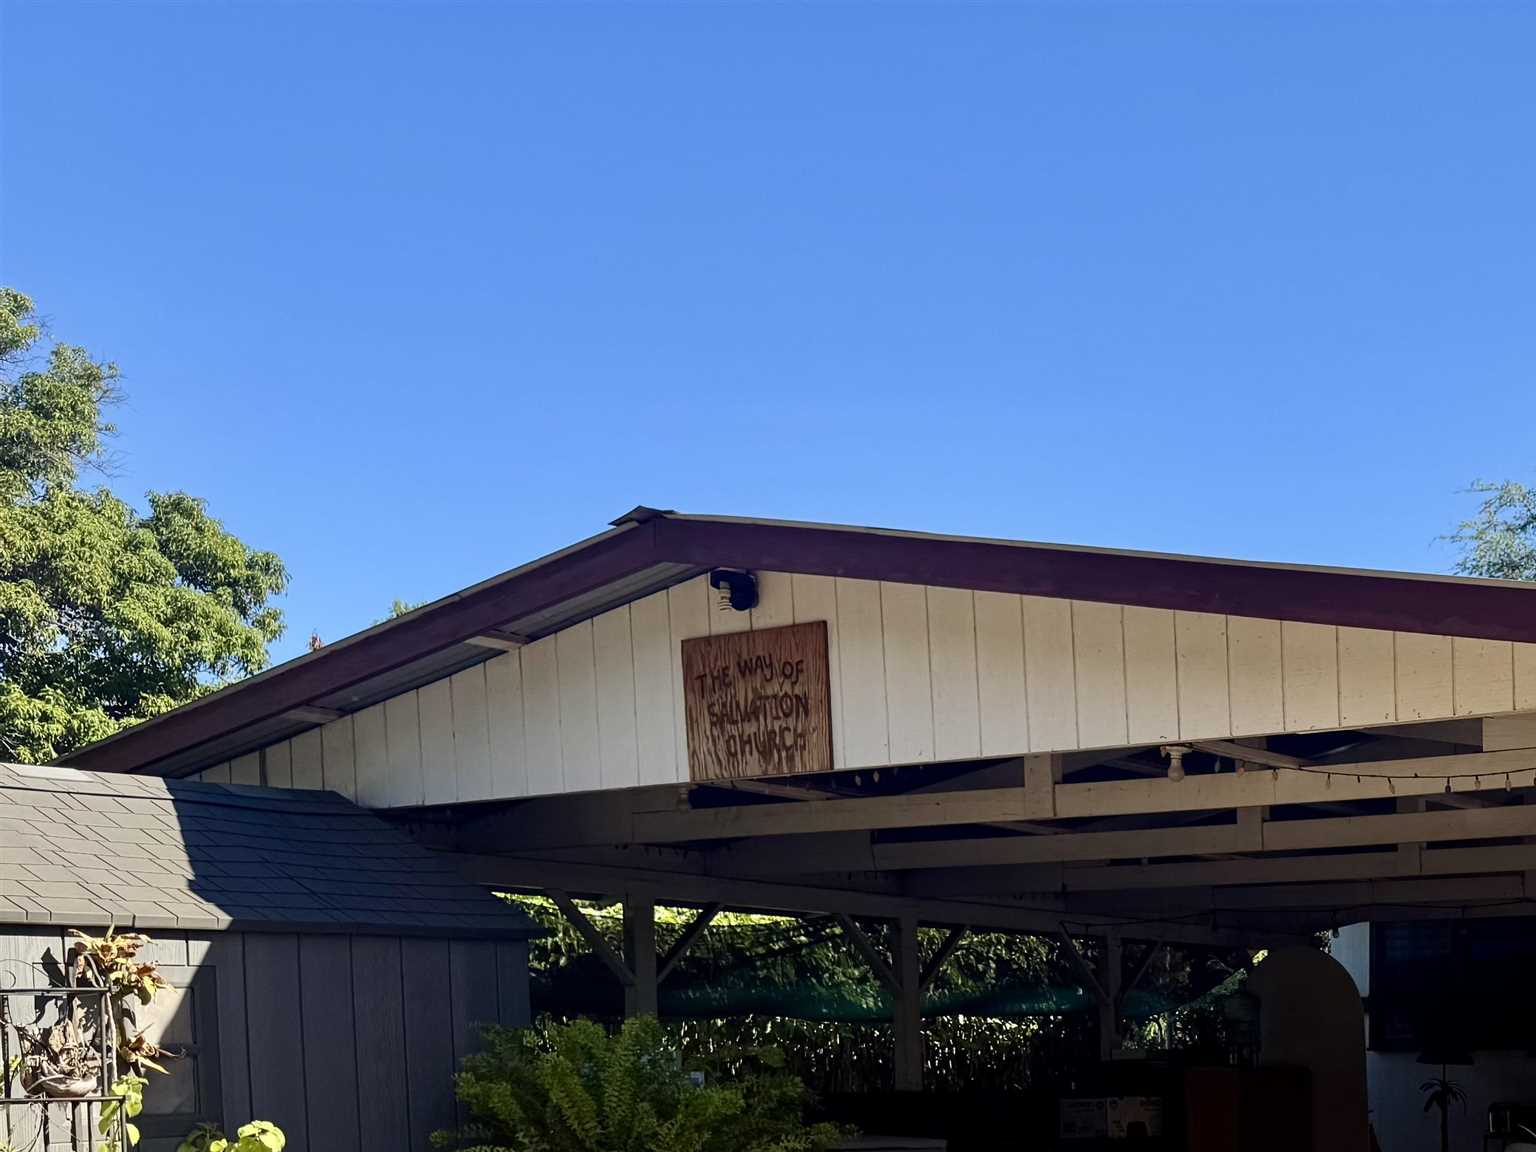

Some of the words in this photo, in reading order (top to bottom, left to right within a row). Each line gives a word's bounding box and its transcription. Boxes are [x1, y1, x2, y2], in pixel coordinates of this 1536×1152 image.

[695, 666, 732, 699] THE
[737, 653, 774, 683] WAY
[782, 660, 804, 686] OF
[708, 691, 810, 727] SALVATION
[726, 726, 807, 759] CHURCH
